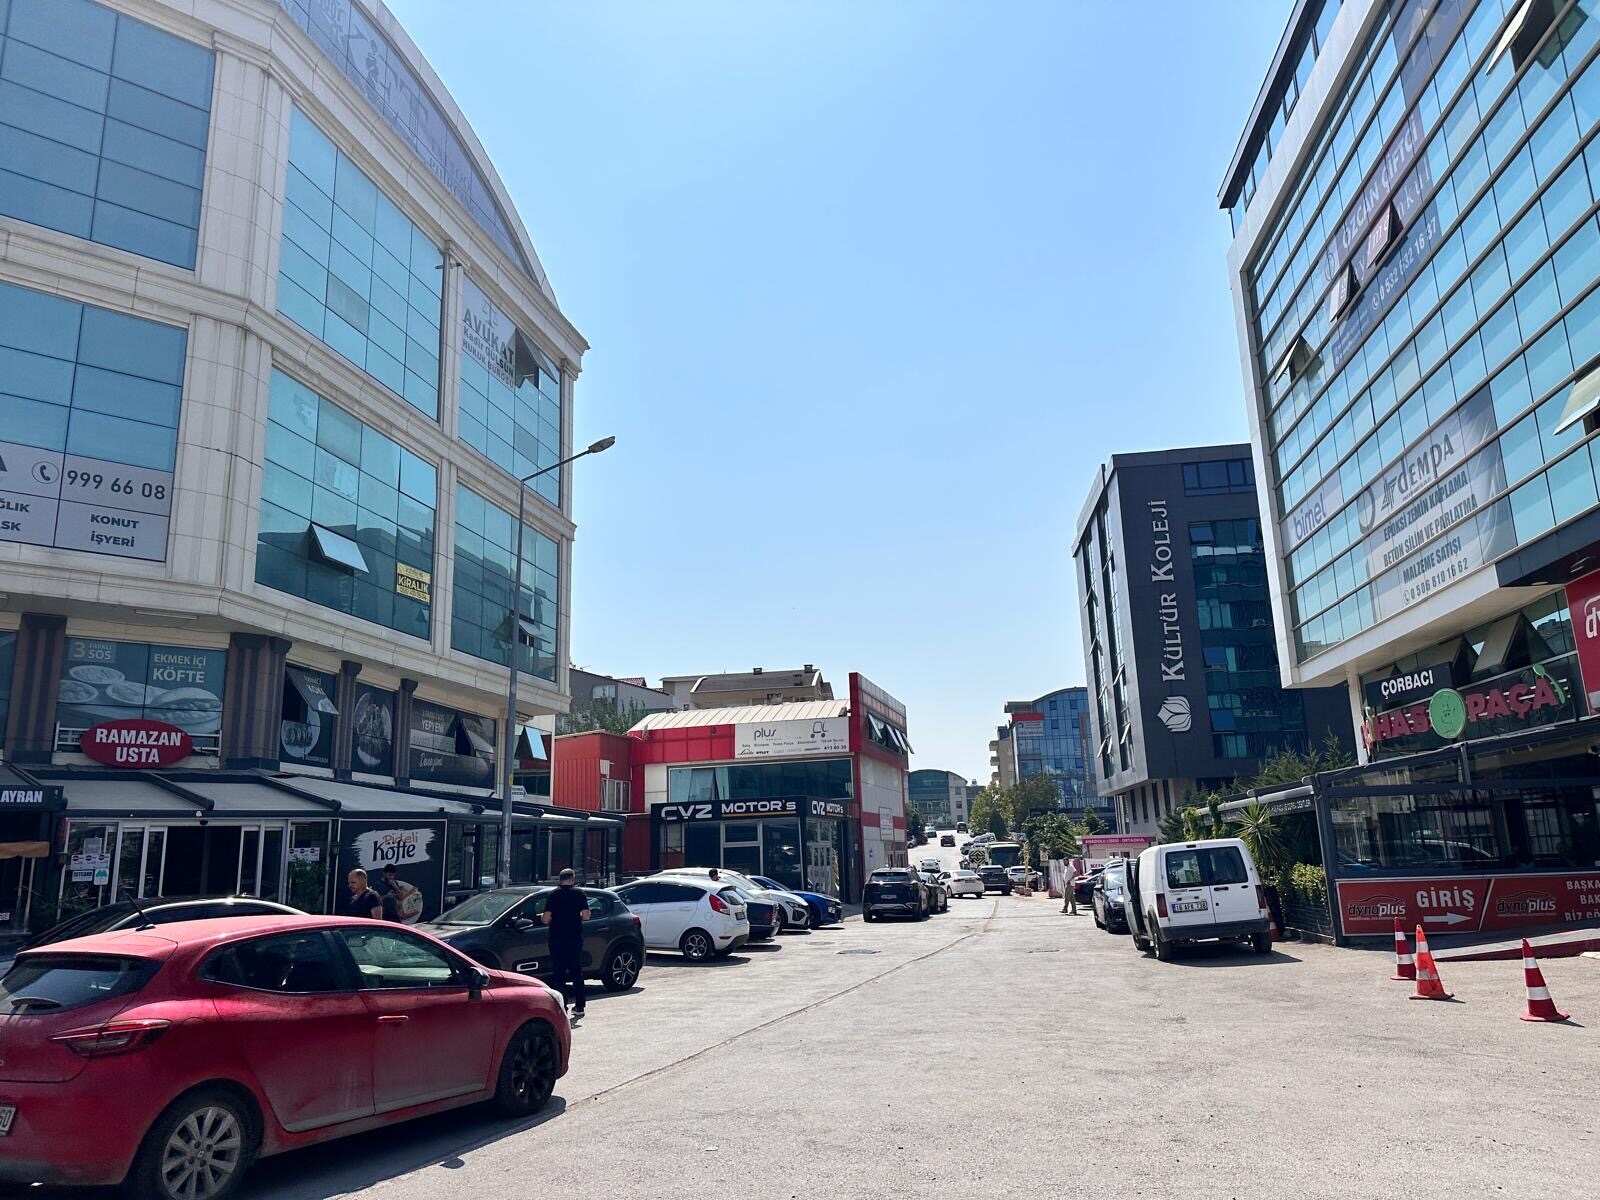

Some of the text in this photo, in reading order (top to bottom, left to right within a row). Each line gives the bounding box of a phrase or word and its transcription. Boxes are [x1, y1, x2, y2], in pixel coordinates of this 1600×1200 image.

[1342, 182, 1380, 249] ÖZCAN
[464, 307, 514, 365] AVUKAT
[66, 469, 166, 500] 999 66 08
[1406, 497, 1429, 526] ZEMİN
[1428, 470, 1469, 509] KAPLAMA
[90, 513, 140, 529] KONUT
[1383, 493, 1478, 567] BETON SİLİM VE PARLATMA
[90, 532, 136, 548] İŞYERİ
[1402, 536, 1462, 584] MALZEME SATIŞI
[398, 575, 429, 595] KİRALIK
[1410, 587, 1416, 600] 0
[1416, 579, 1431, 597] 506
[1431, 570, 1446, 588] 810
[1457, 557, 1469, 574] 62
[73, 641, 86, 658] 3
[87, 649, 112, 660] SOS
[154, 653, 206, 668] EKMEK İÇİ
[152, 666, 206, 683] KÖFTE
[1381, 669, 1434, 700] ÇORBACI
[1372, 673, 1560, 741] HAS PAÇA
[95, 728, 182, 747] RAMAZAN
[753, 727, 777, 741] plus
[115, 747, 160, 763] USTA
[1, 790, 43, 803] AYRAN
[811, 800, 826, 815] CVZ
[1416, 886, 1475, 911] GİRİŞ
[1497, 899, 1556, 913] dynoplus
[1348, 903, 1406, 917] dynoplus
